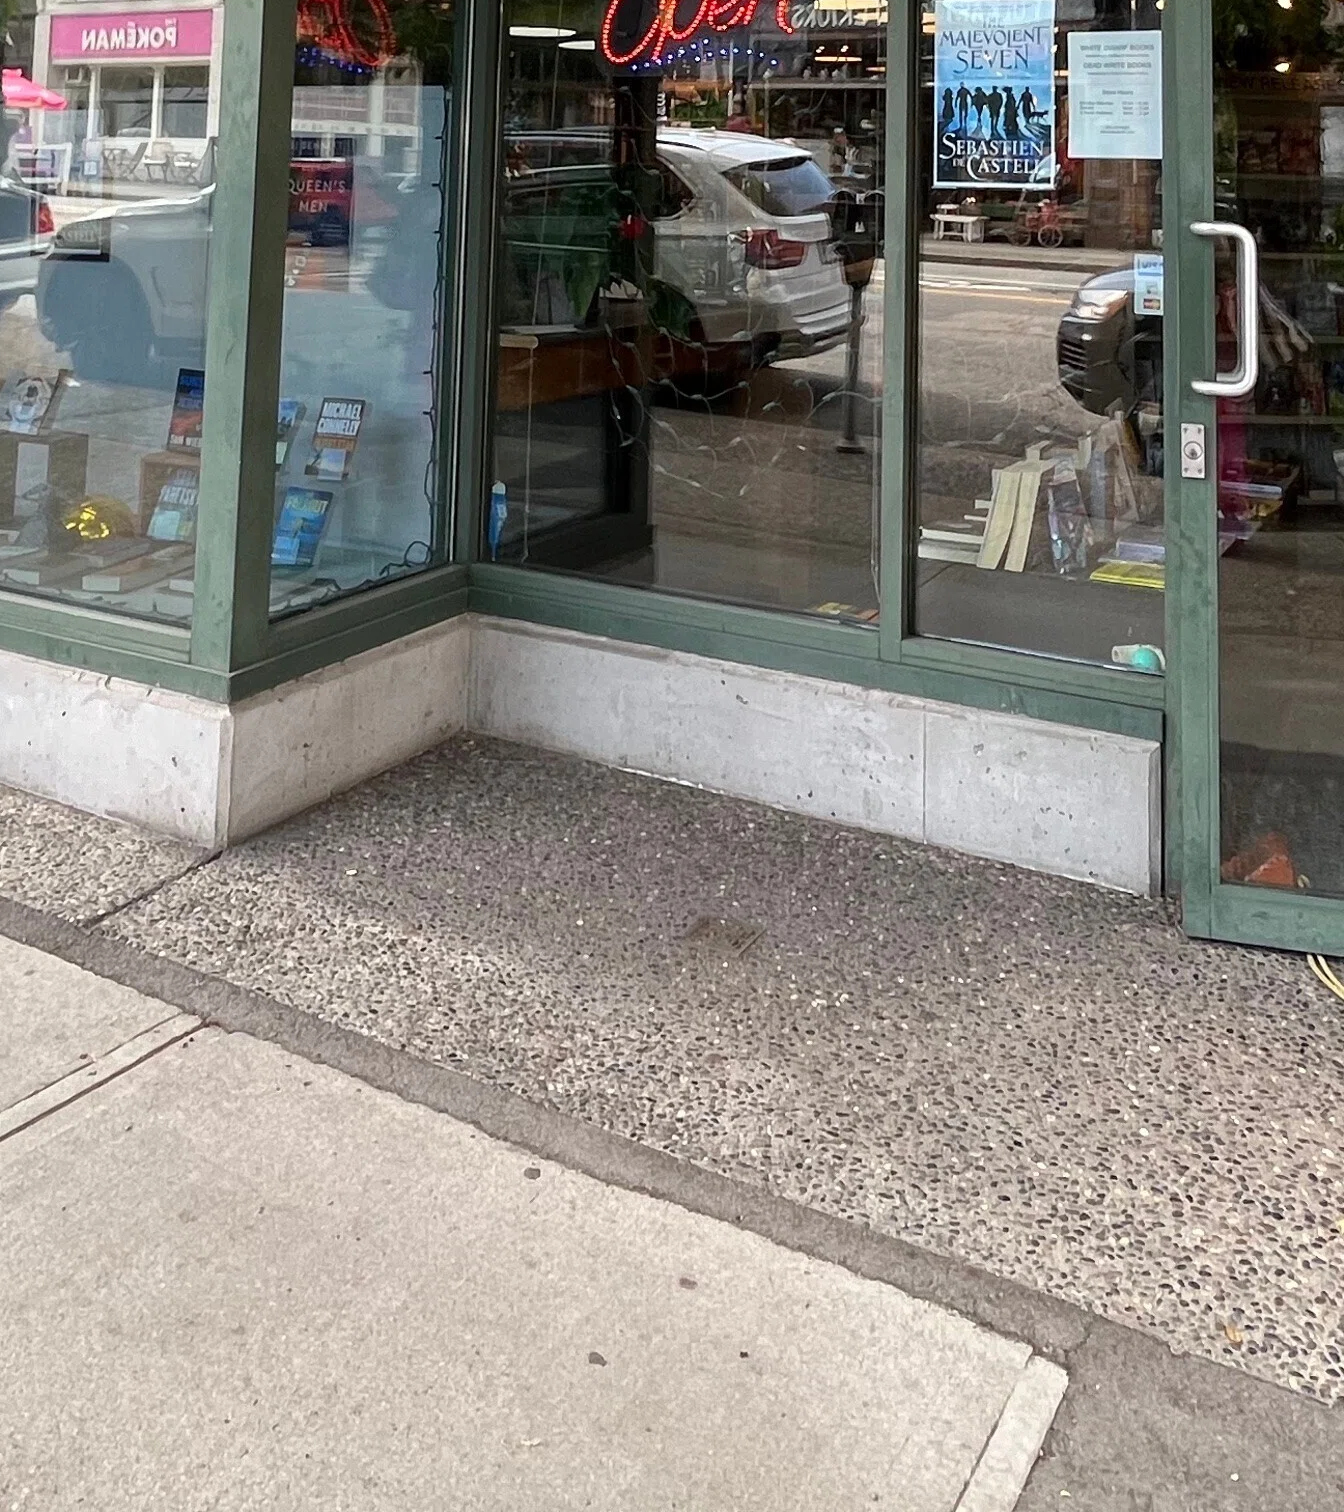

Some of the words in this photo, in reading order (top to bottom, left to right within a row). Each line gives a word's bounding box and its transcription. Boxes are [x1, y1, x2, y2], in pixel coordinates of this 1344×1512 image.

[939, 26, 1050, 48] MALEVOLENT
[953, 44, 1030, 74] SEVEN
[939, 133, 1045, 160] SEBASTIEN
[288, 179, 346, 195] QUEEN'S
[298, 199, 328, 213] MEN
[323, 400, 363, 420] MICHAEL
